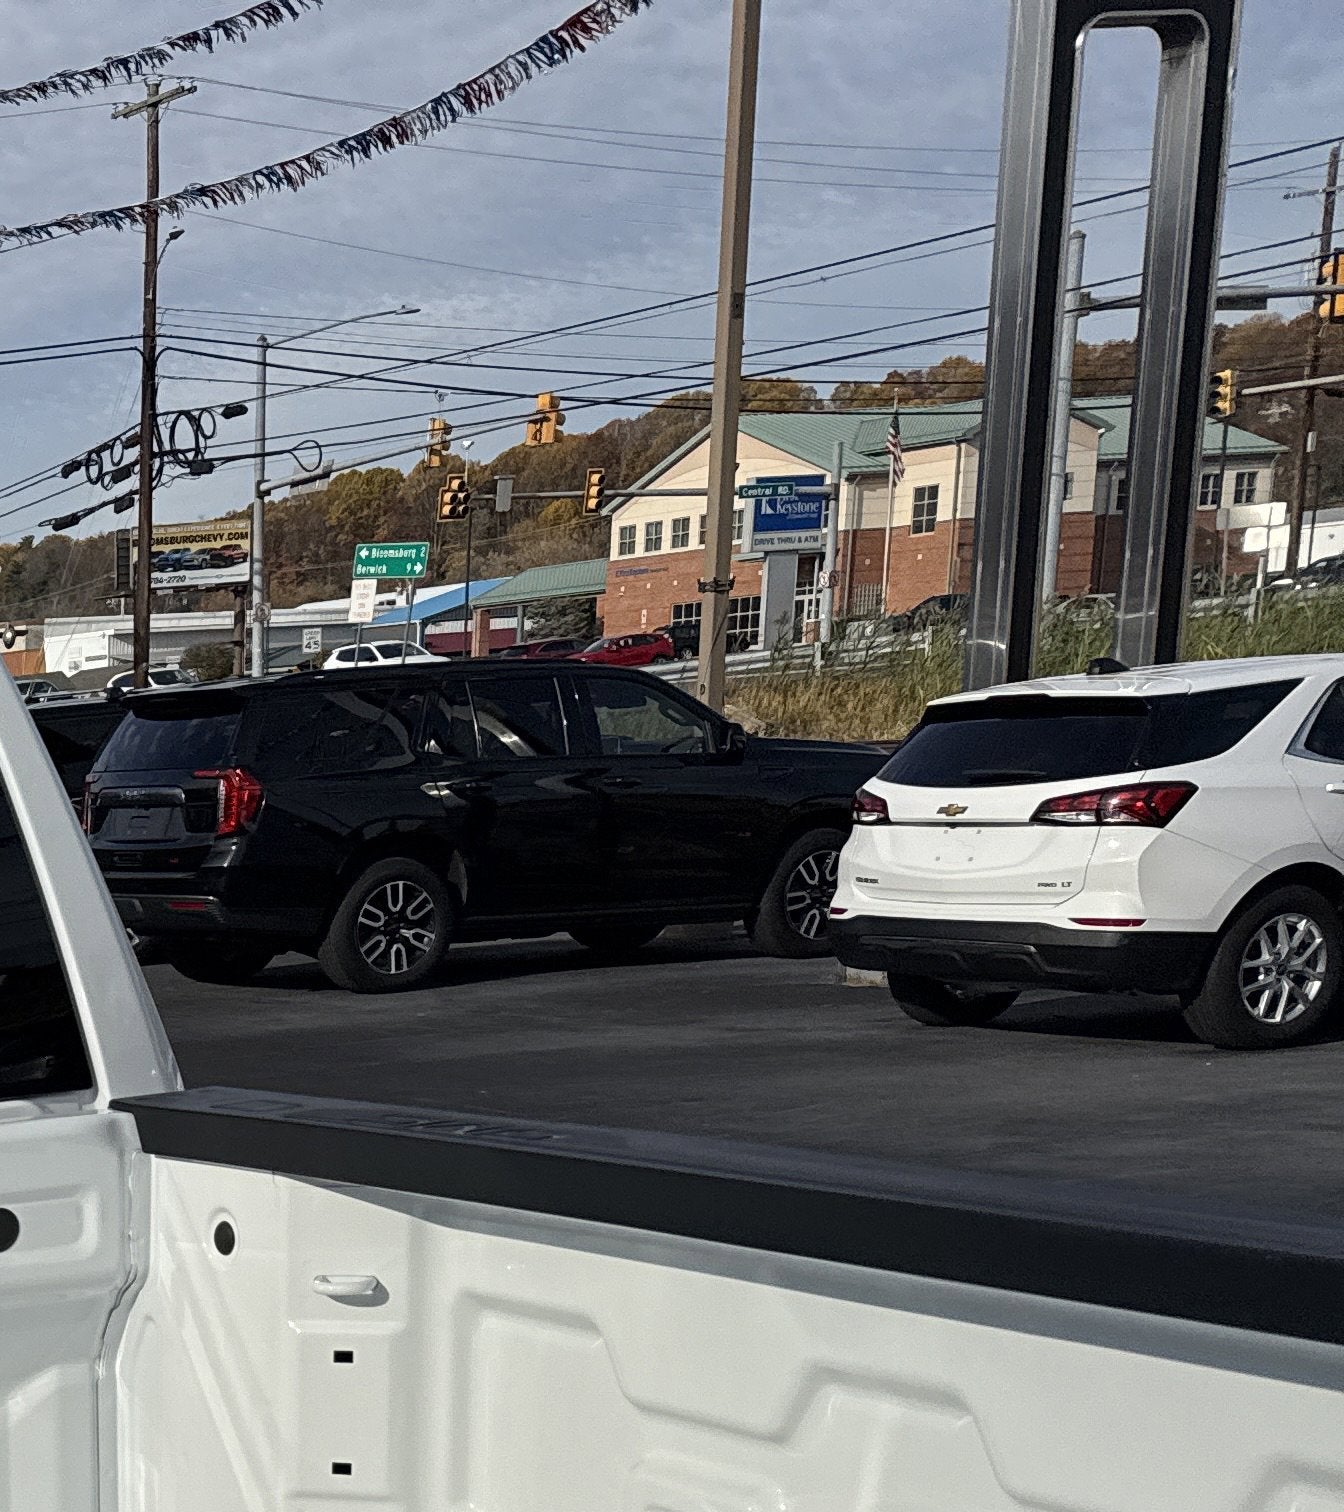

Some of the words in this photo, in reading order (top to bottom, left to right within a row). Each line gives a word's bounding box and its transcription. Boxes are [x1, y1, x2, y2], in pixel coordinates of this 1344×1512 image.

[742, 486, 772, 496] Central
[776, 498, 820, 514] Keystone
[149, 531, 249, 547] OMSBURGCHEVY.COM
[754, 538, 776, 546] DRIVE
[777, 536, 797, 544] THRU
[804, 535, 819, 543] ATM
[371, 547, 417, 559] Bloomsburg
[420, 546, 426, 557] 2
[356, 563, 387, 574] Berwick
[406, 562, 412, 574] 9
[305, 640, 319, 649] 45
